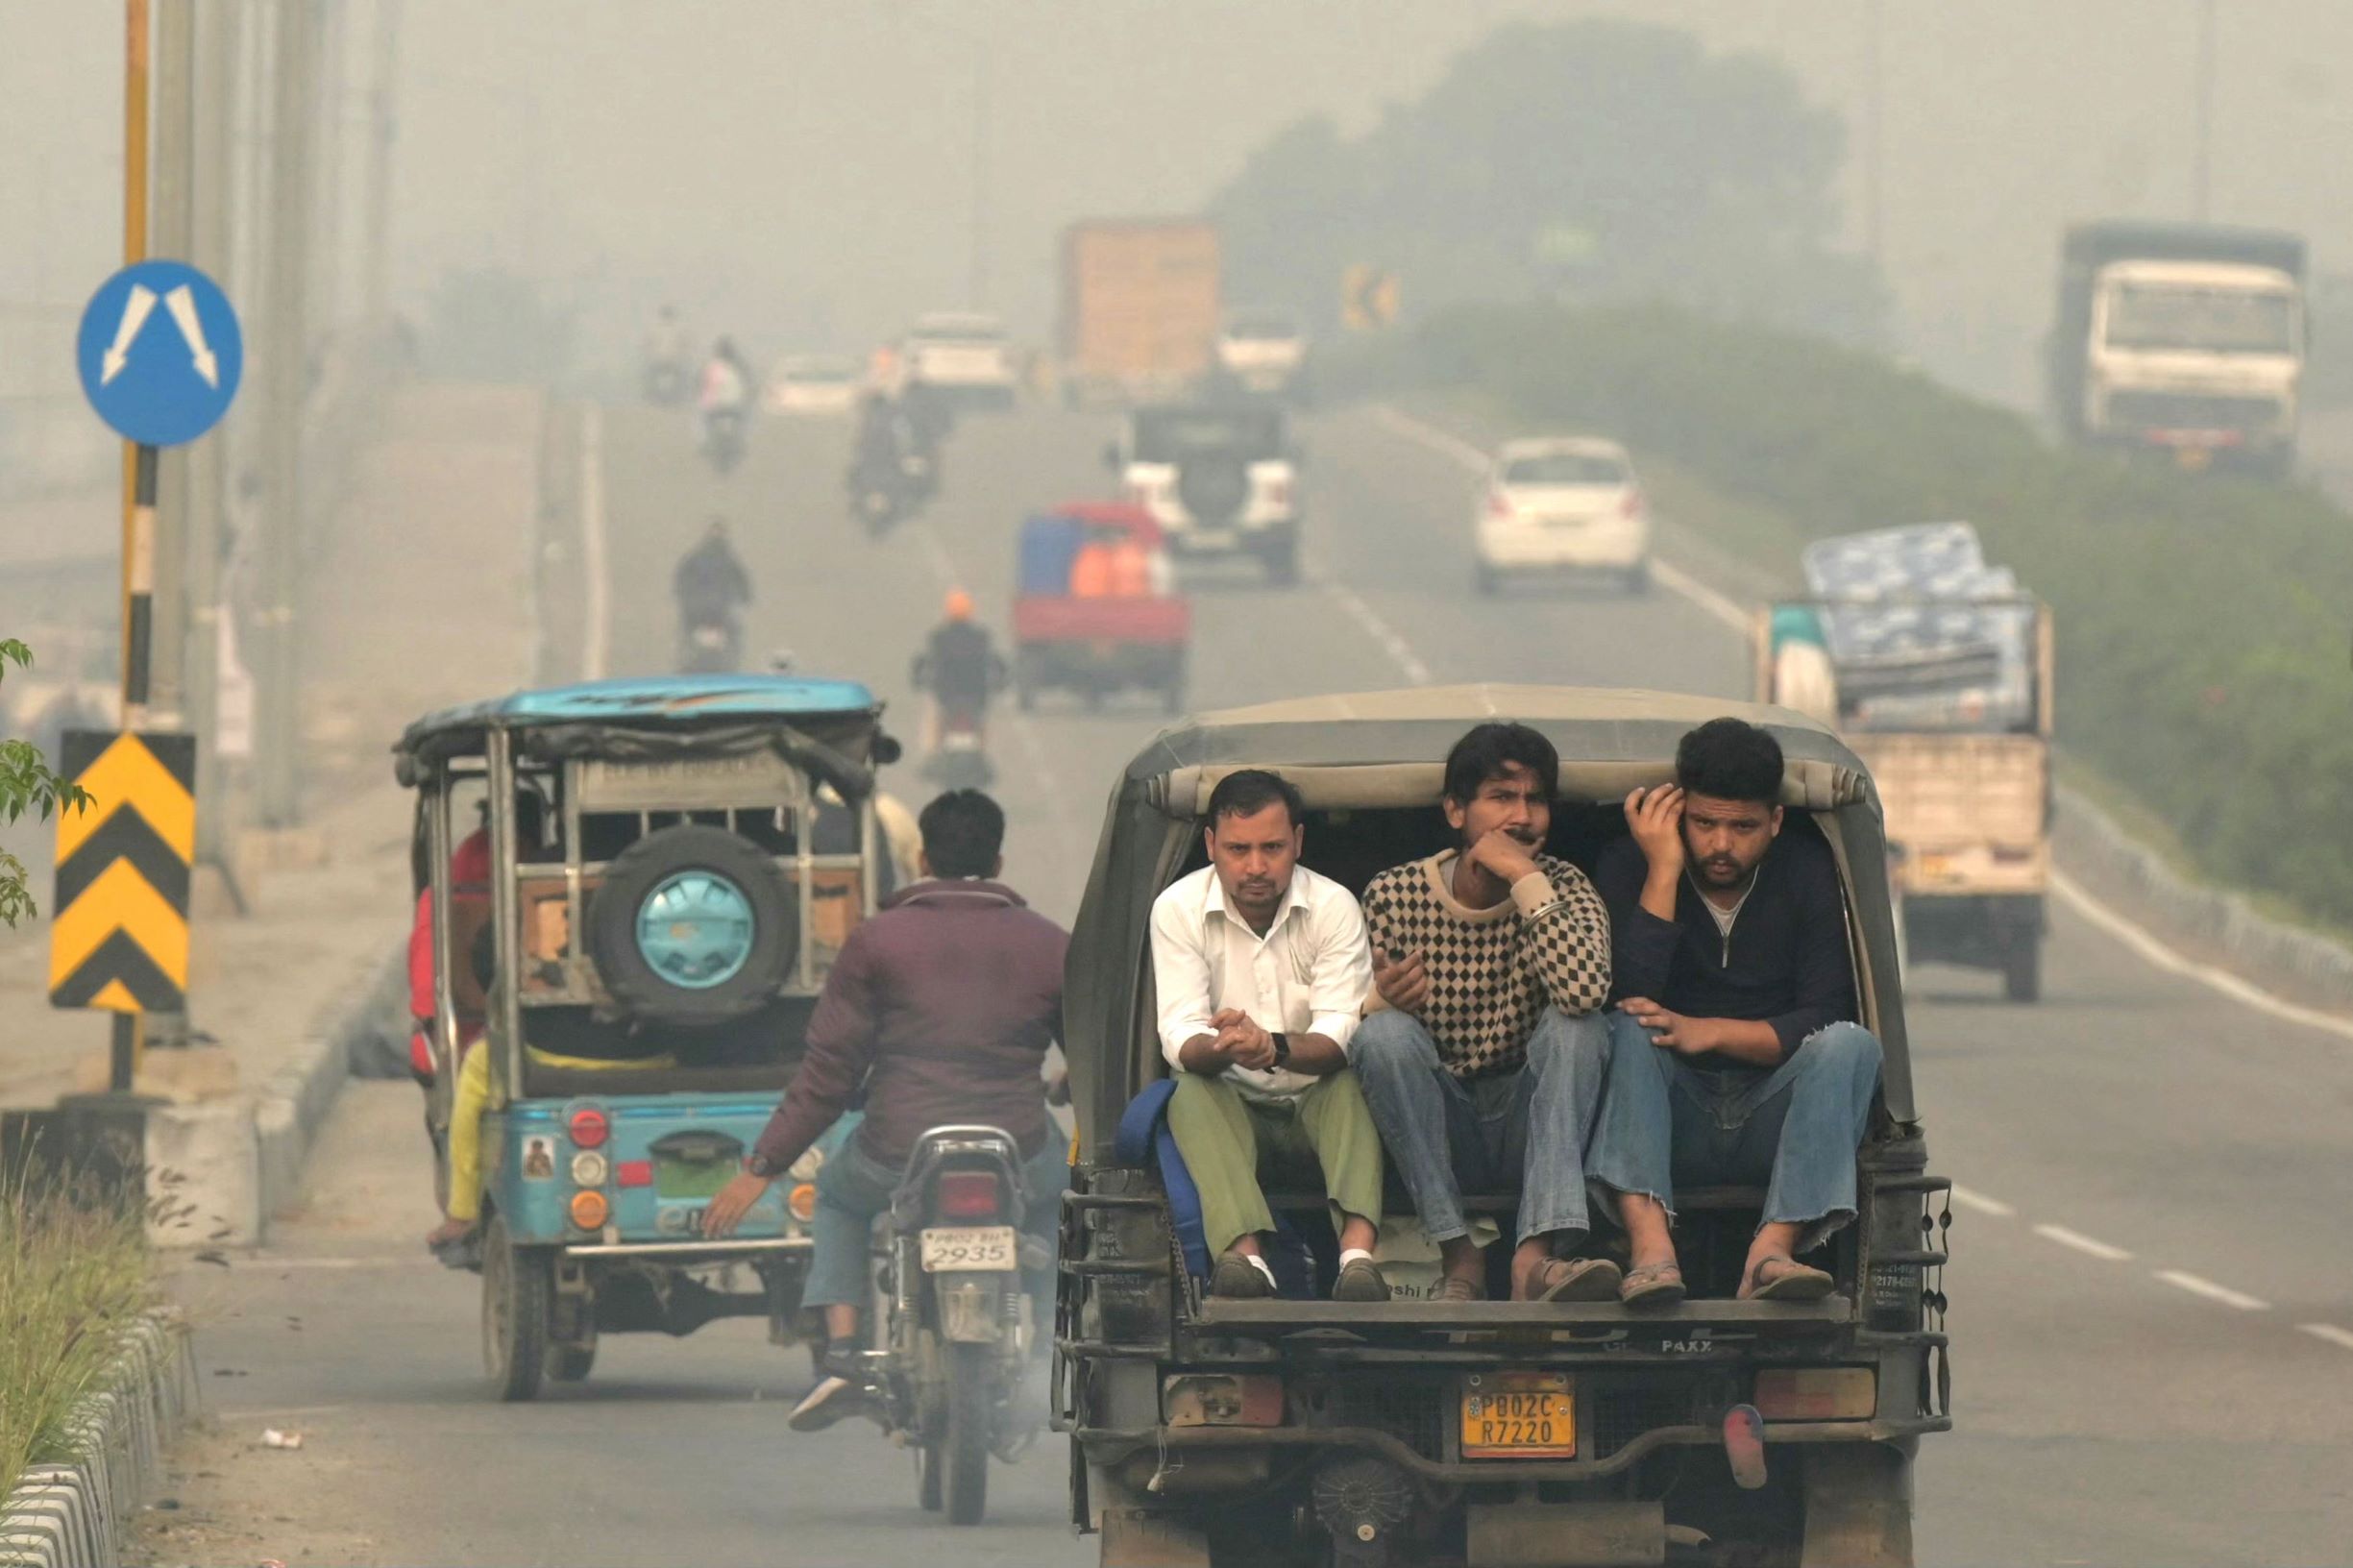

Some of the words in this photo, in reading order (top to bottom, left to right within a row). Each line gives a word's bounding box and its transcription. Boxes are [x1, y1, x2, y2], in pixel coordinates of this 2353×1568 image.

[932, 1245, 1007, 1264] 2935
[1481, 1394, 1554, 1417] PB02C
[1481, 1420, 1553, 1444] R7220
